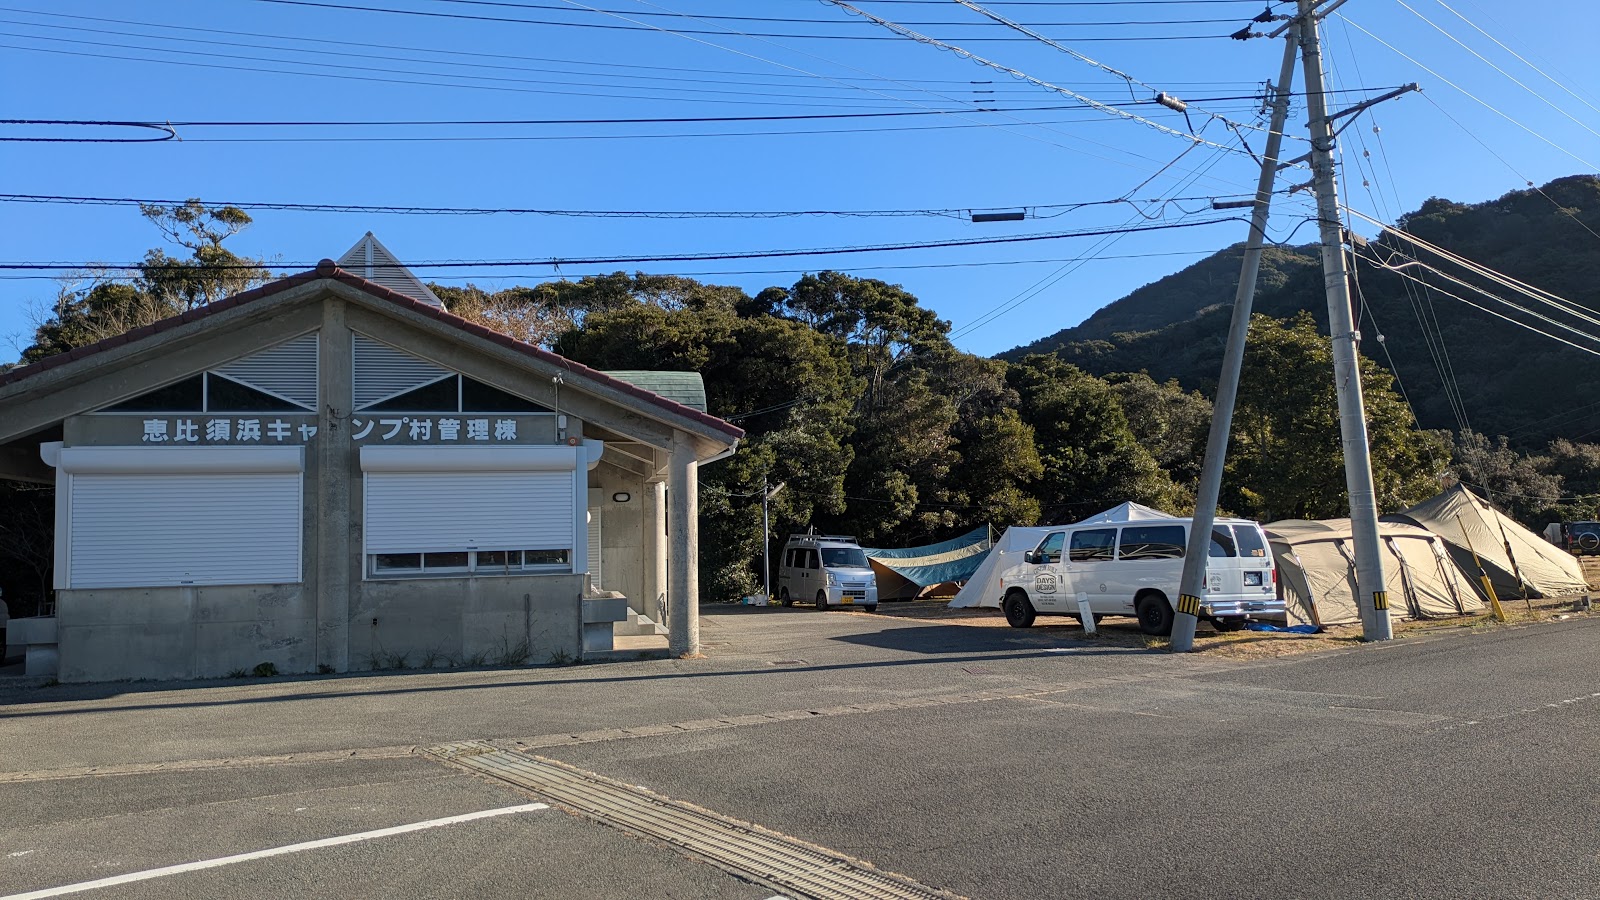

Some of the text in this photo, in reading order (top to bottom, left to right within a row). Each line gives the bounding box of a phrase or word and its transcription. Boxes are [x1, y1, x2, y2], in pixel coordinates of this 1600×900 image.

[142, 417, 517, 442] 恵比須浜キャンプ村管理棟
